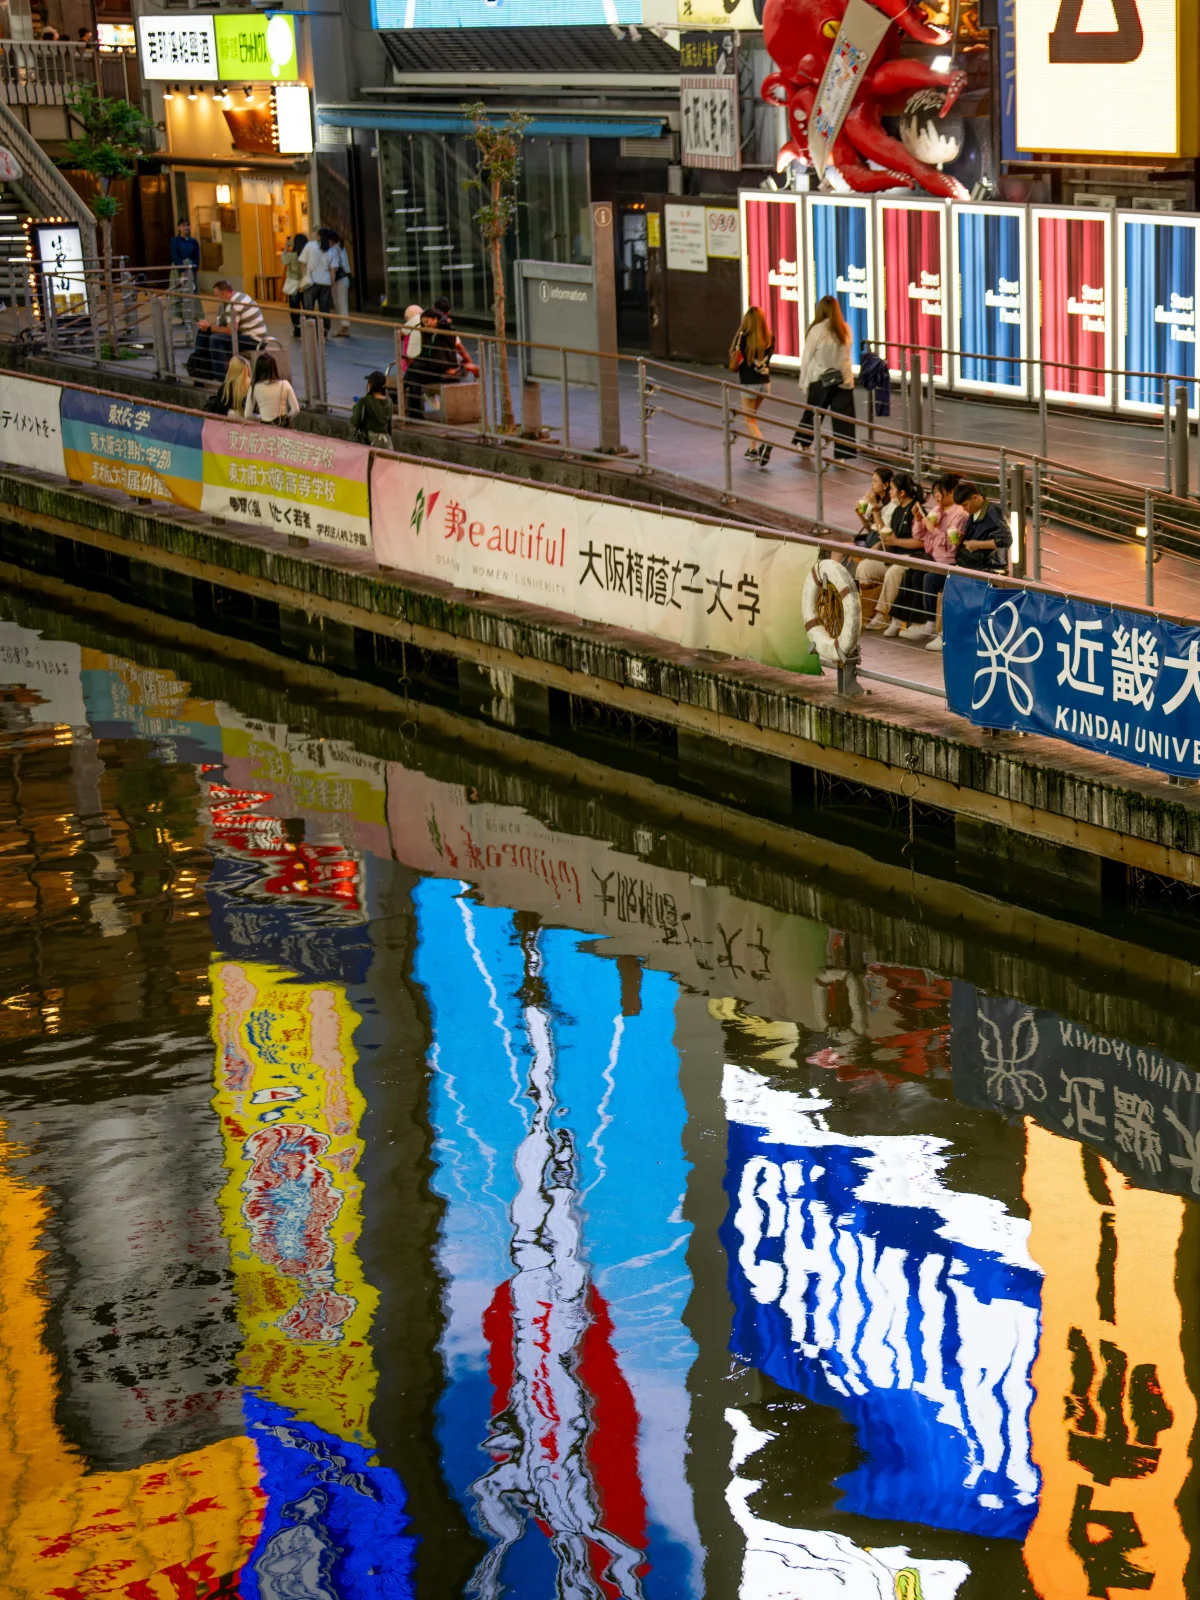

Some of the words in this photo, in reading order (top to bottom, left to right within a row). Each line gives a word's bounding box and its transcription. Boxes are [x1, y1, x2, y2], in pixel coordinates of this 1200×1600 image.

[550, 286, 588, 302] information
[472, 564, 519, 583] WOMEN'S
[1055, 705, 1129, 747] KINDAI
